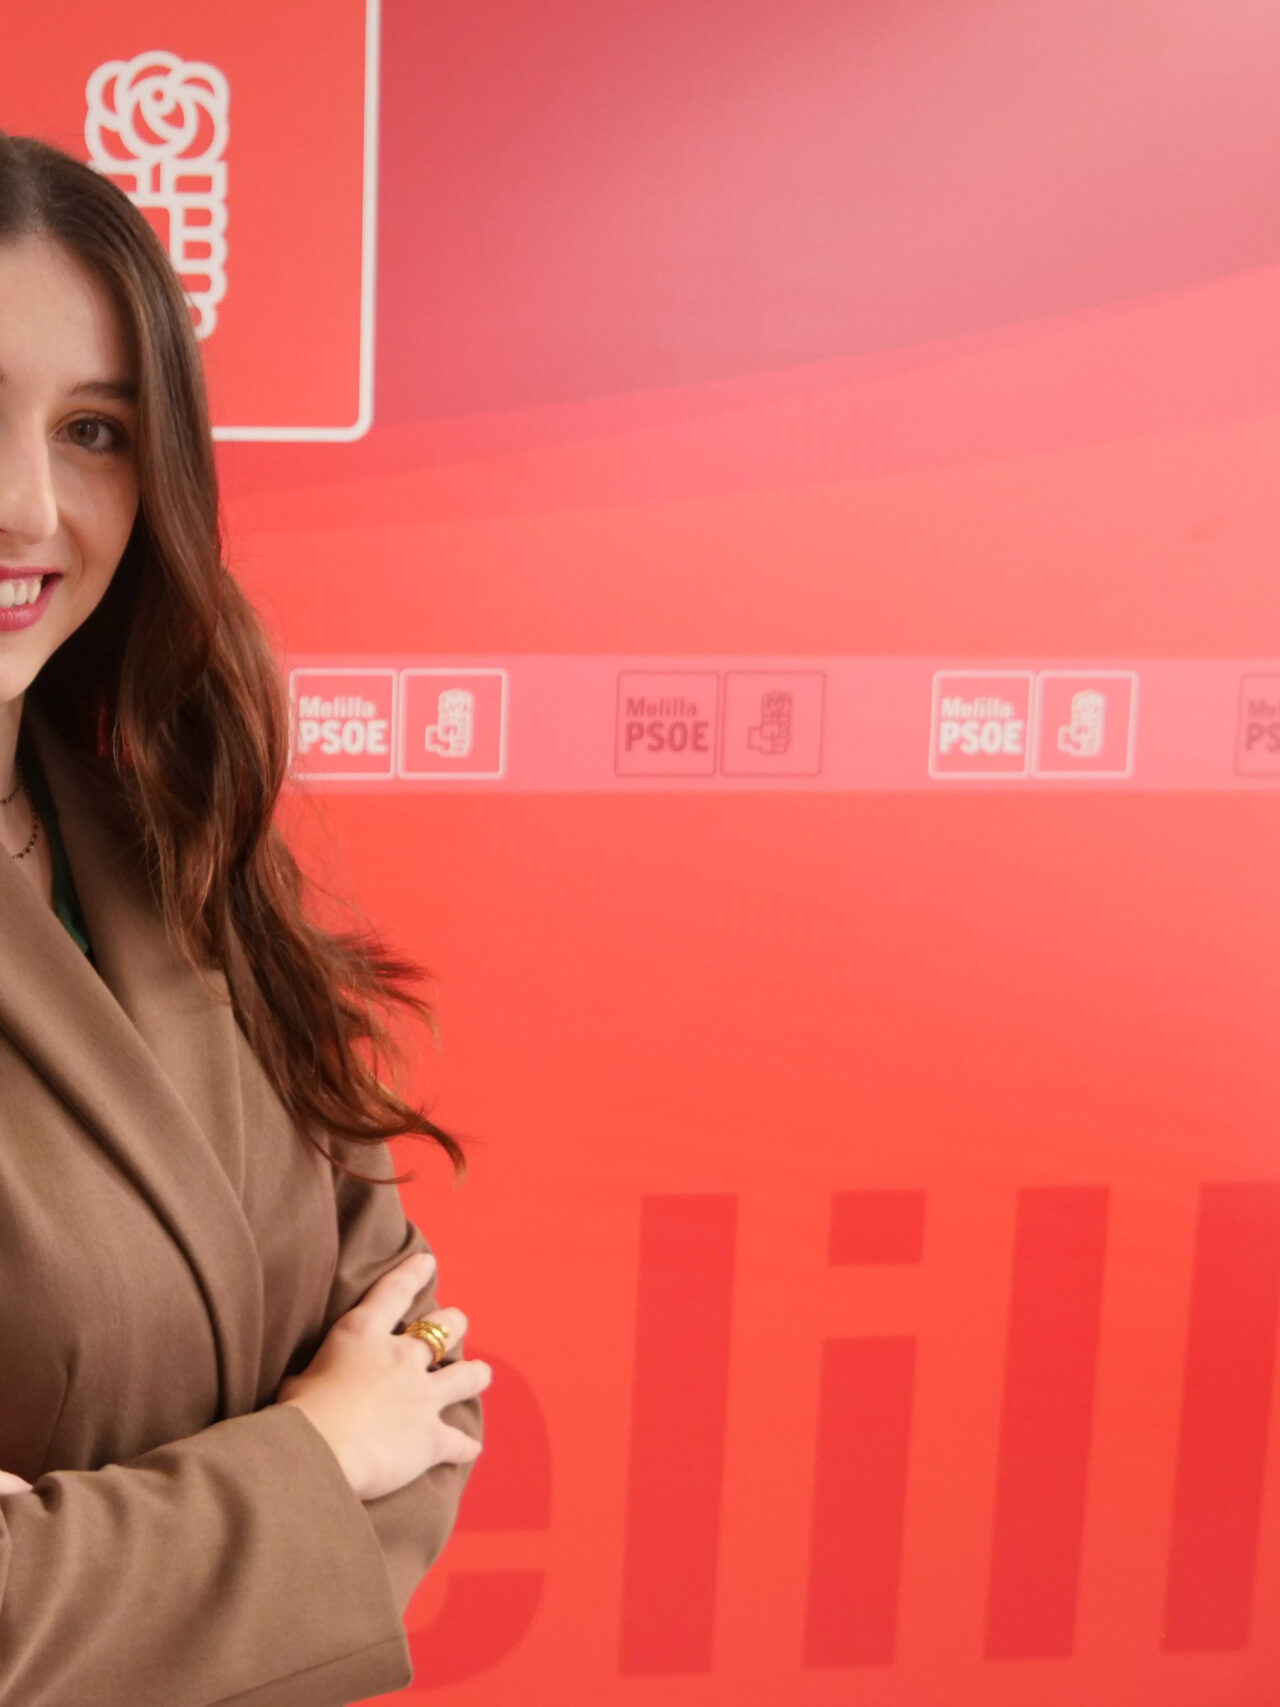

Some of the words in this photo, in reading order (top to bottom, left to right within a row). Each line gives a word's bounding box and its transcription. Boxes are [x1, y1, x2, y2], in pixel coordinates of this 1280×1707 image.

[299, 697, 376, 719] Melilla
[626, 698, 699, 719] Melilla
[940, 697, 1014, 719] Melilla
[300, 719, 388, 754] PSOE
[625, 721, 709, 752] PSOE
[939, 720, 1024, 754] PSOE
